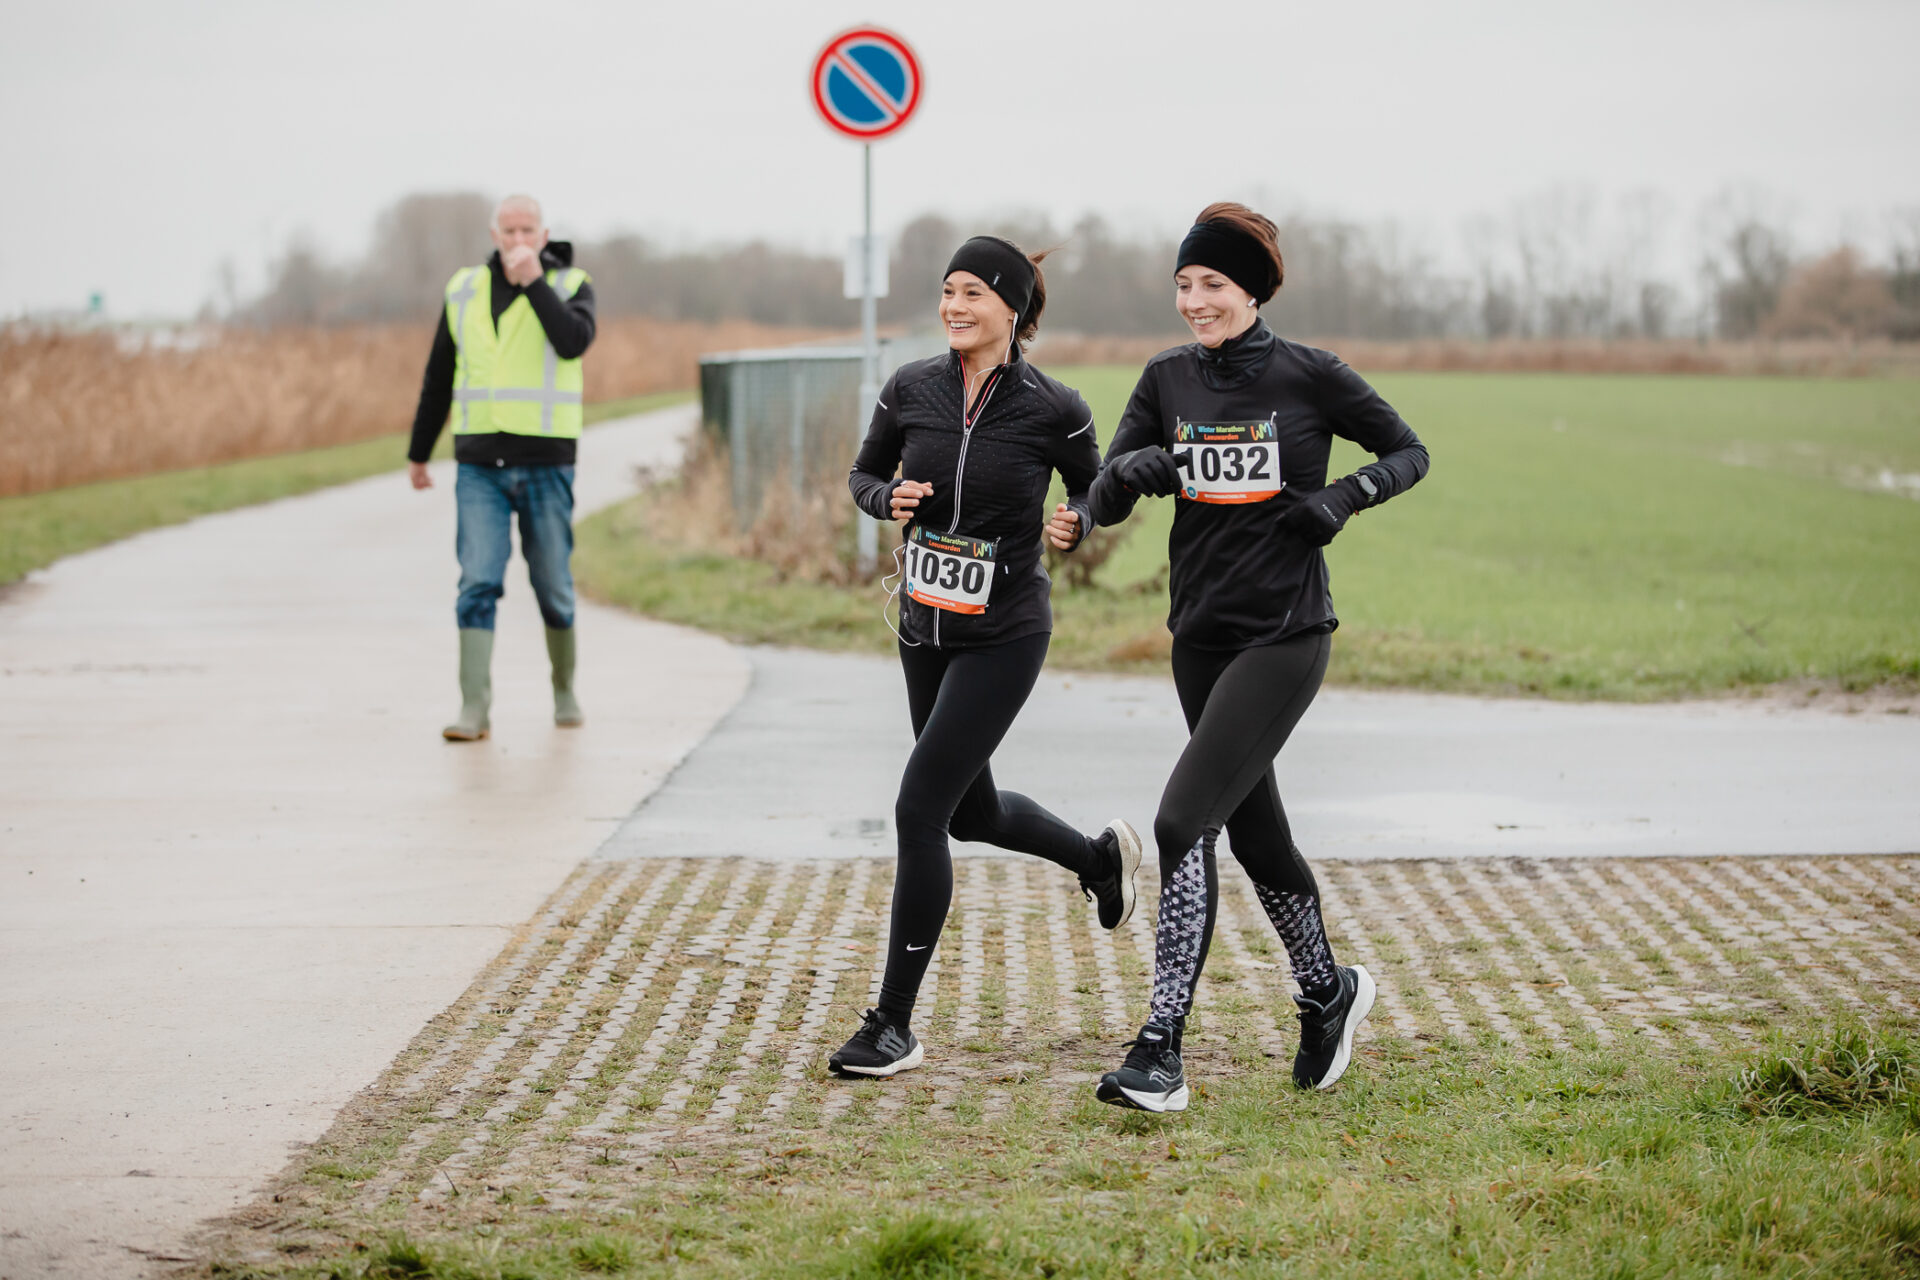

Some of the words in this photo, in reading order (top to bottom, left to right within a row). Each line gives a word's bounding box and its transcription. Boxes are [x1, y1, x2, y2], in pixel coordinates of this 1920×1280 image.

[1216, 425, 1246, 433] Marathon
[1185, 446, 1270, 482] 1032
[925, 530, 941, 542] Winter
[941, 534, 969, 547] Marathon
[928, 540, 961, 552] Leeuwarden
[910, 546, 985, 594] 1030
